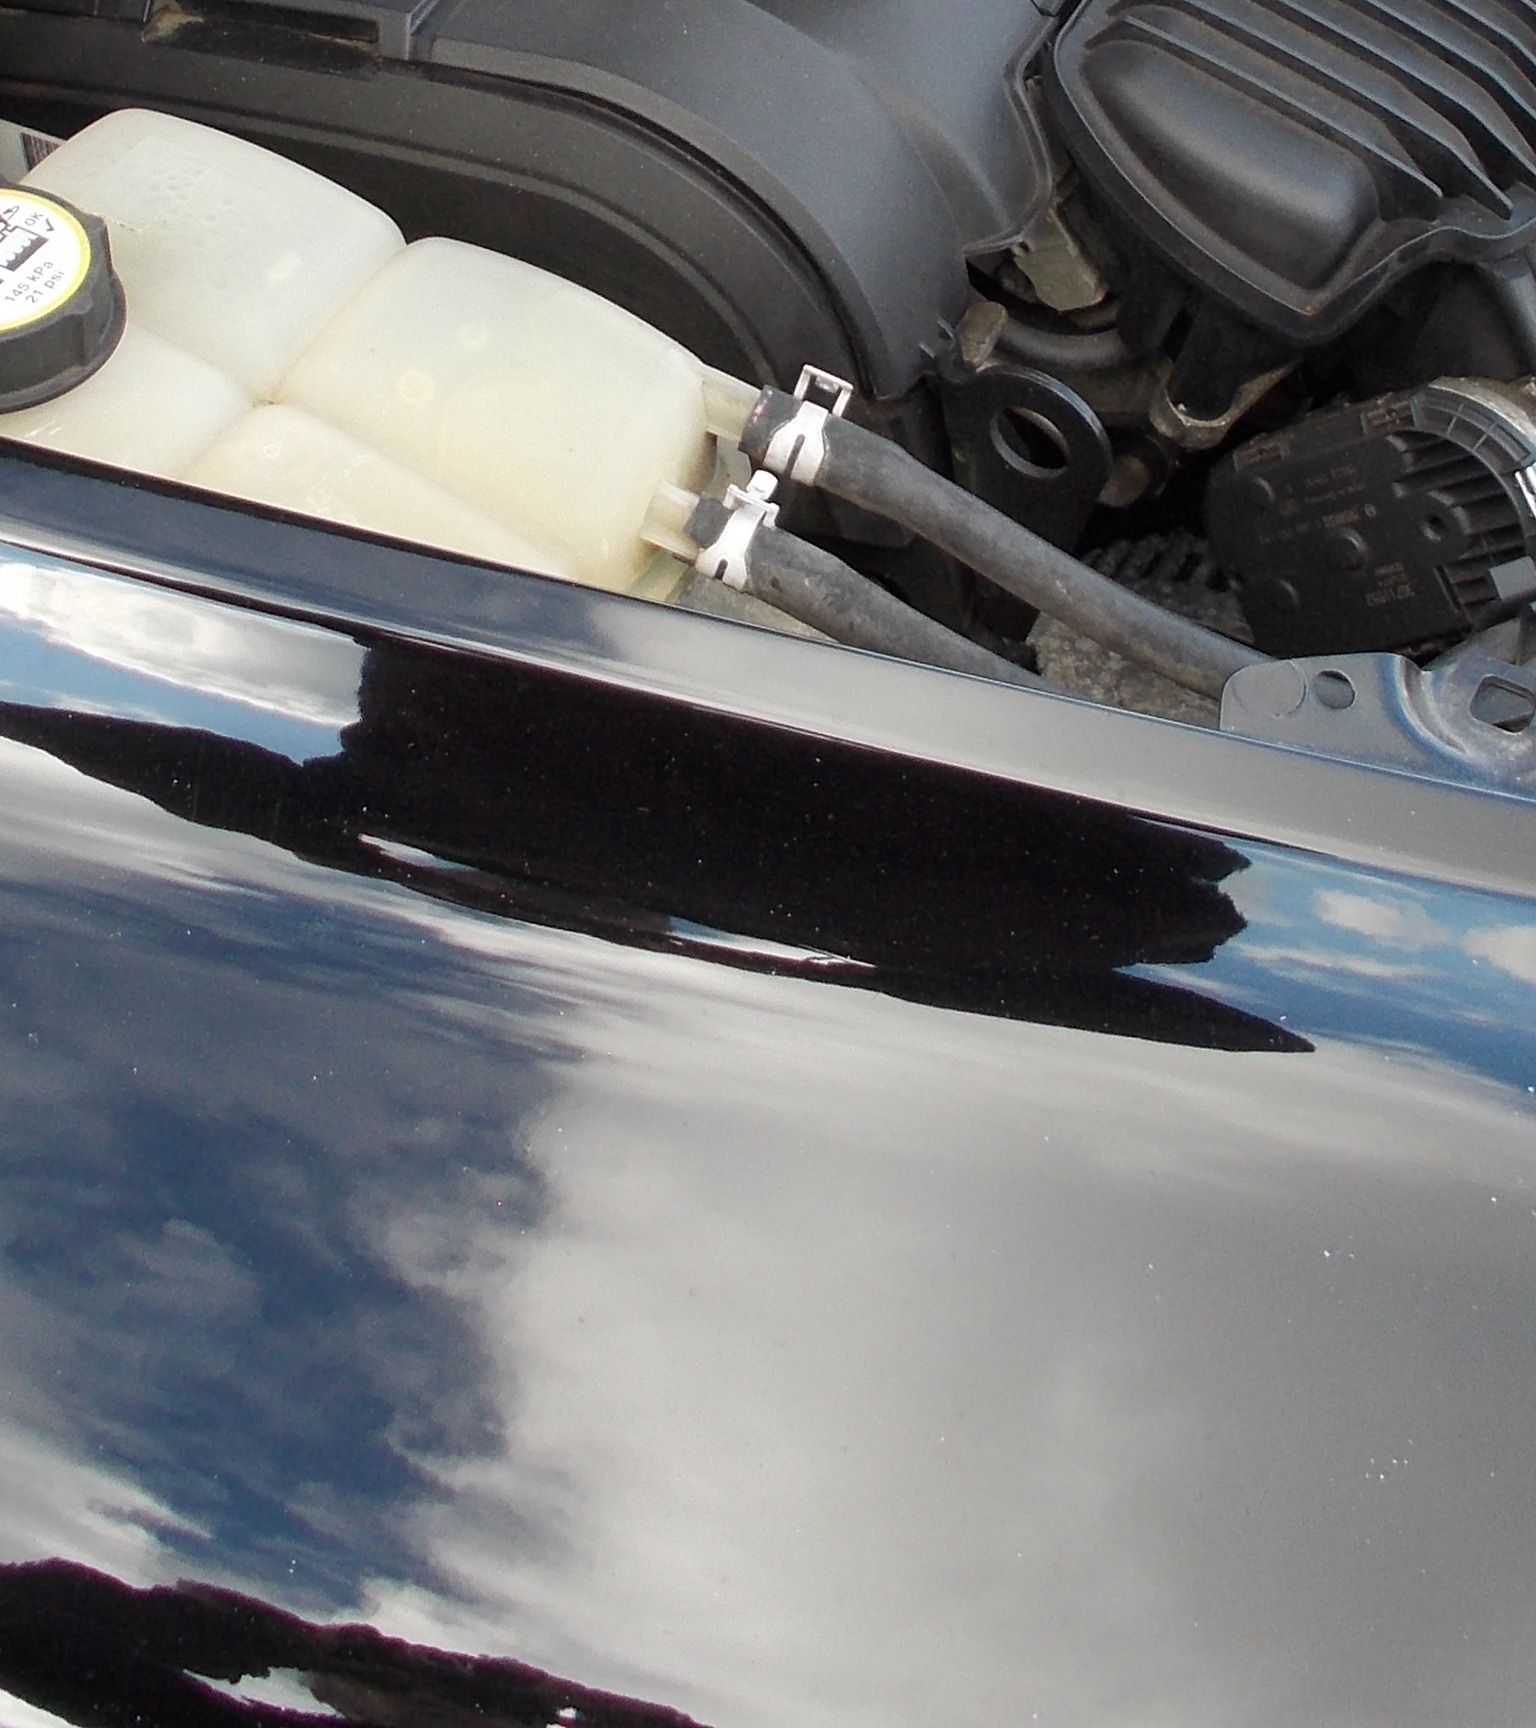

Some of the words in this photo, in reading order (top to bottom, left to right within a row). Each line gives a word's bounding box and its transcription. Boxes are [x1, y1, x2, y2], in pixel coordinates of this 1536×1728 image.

[24, 211, 44, 226] OK
[5, 282, 29, 302] 145
[29, 261, 54, 281] kPa
[26, 288, 42, 303] 21
[44, 270, 65, 290] psi
